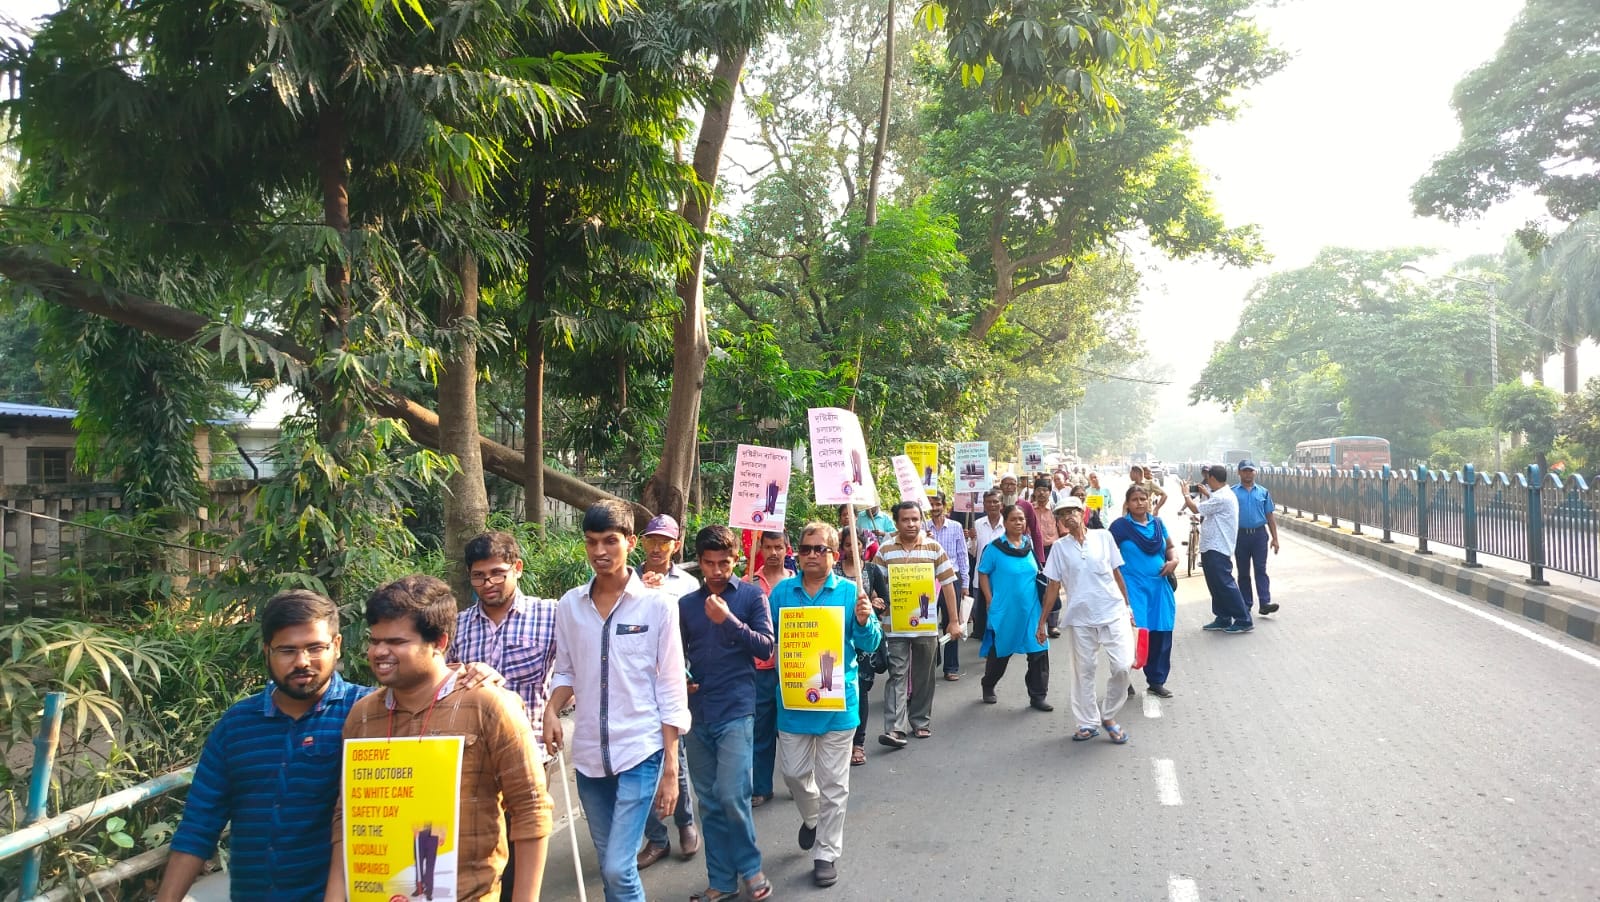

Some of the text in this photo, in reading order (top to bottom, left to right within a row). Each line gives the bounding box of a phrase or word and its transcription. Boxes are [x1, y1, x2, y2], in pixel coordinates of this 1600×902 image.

[791, 631, 805, 639] WHITE
[352, 748, 390, 761] OBSERVE
[352, 768, 413, 780] 15TH OCTOBER
[352, 786, 414, 799] AS WHITE CANE
[352, 806, 400, 818] SAFETY DAY
[352, 825, 383, 837] FOR THE
[352, 844, 388, 856] VISUALLY
[353, 863, 389, 875] IMPAIRED
[354, 881, 385, 893] PERSON.
